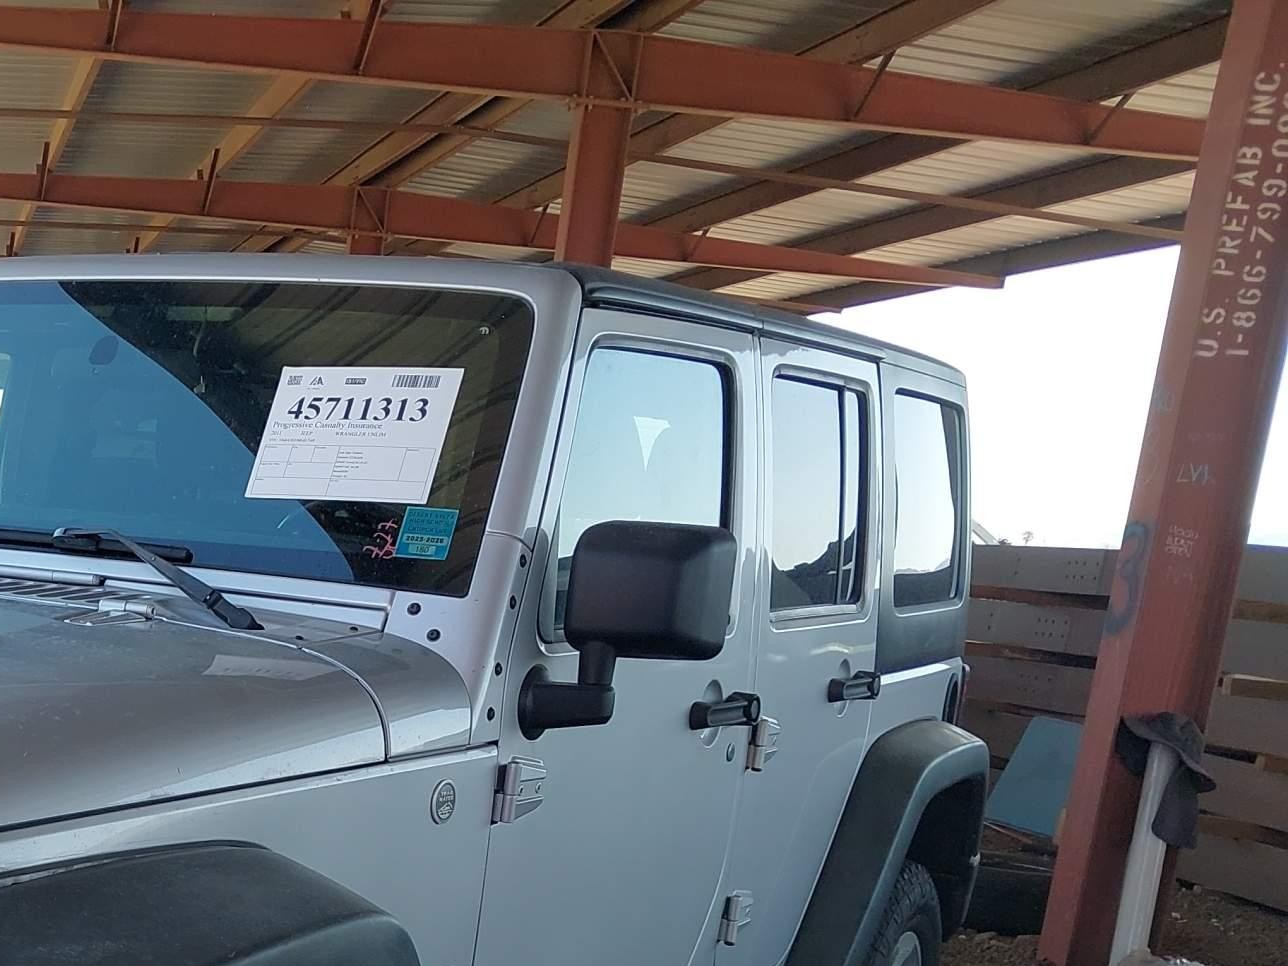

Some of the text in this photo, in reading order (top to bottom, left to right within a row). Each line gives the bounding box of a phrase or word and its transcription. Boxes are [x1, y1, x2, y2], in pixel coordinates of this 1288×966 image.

[1212, 145, 1263, 276] PREFAB
[1246, 62, 1286, 126] INC.
[287, 396, 429, 422] 45711313
[272, 421, 383, 430] Progressive Casualty Insurance
